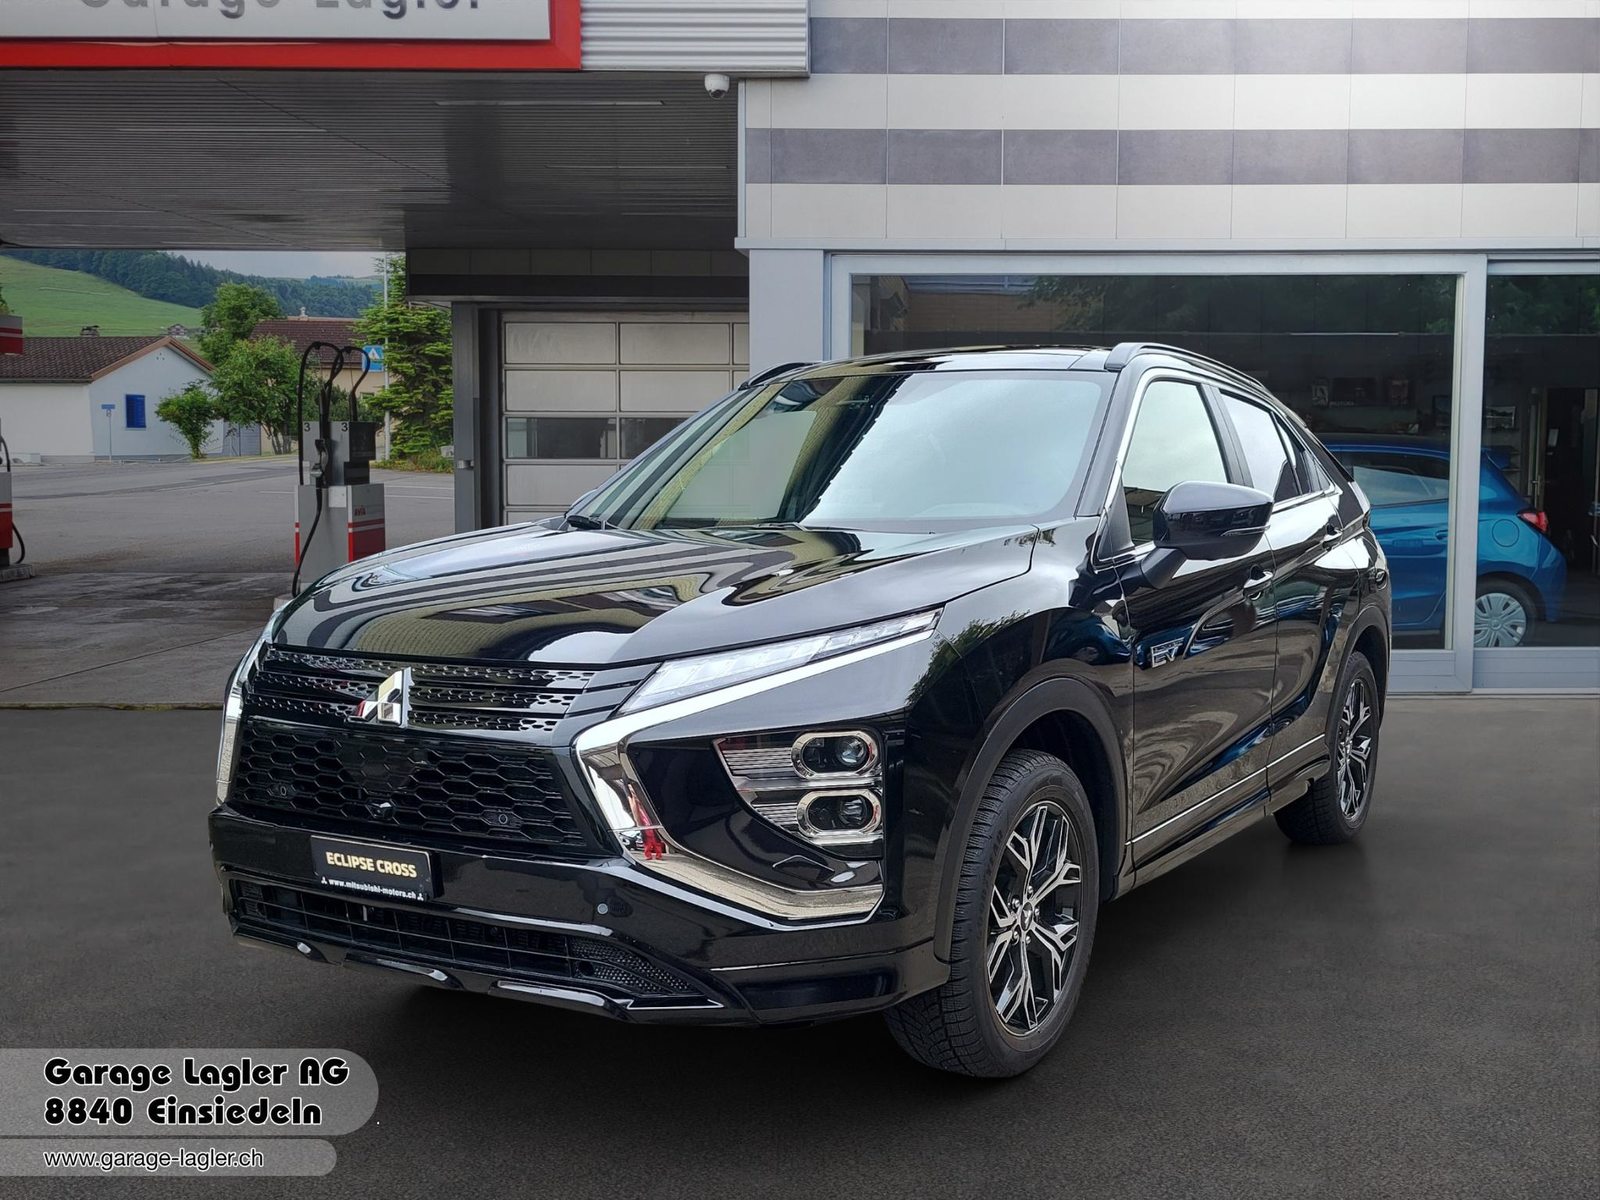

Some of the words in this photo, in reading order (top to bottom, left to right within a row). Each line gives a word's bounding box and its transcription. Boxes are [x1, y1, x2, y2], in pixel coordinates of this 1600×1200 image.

[304, 422, 311, 432] 3
[341, 422, 348, 432] 3
[325, 851, 375, 871] ECLIPSE
[376, 859, 417, 878] CROSS
[328, 878, 416, 899] www.mitsubishi-motors.ch
